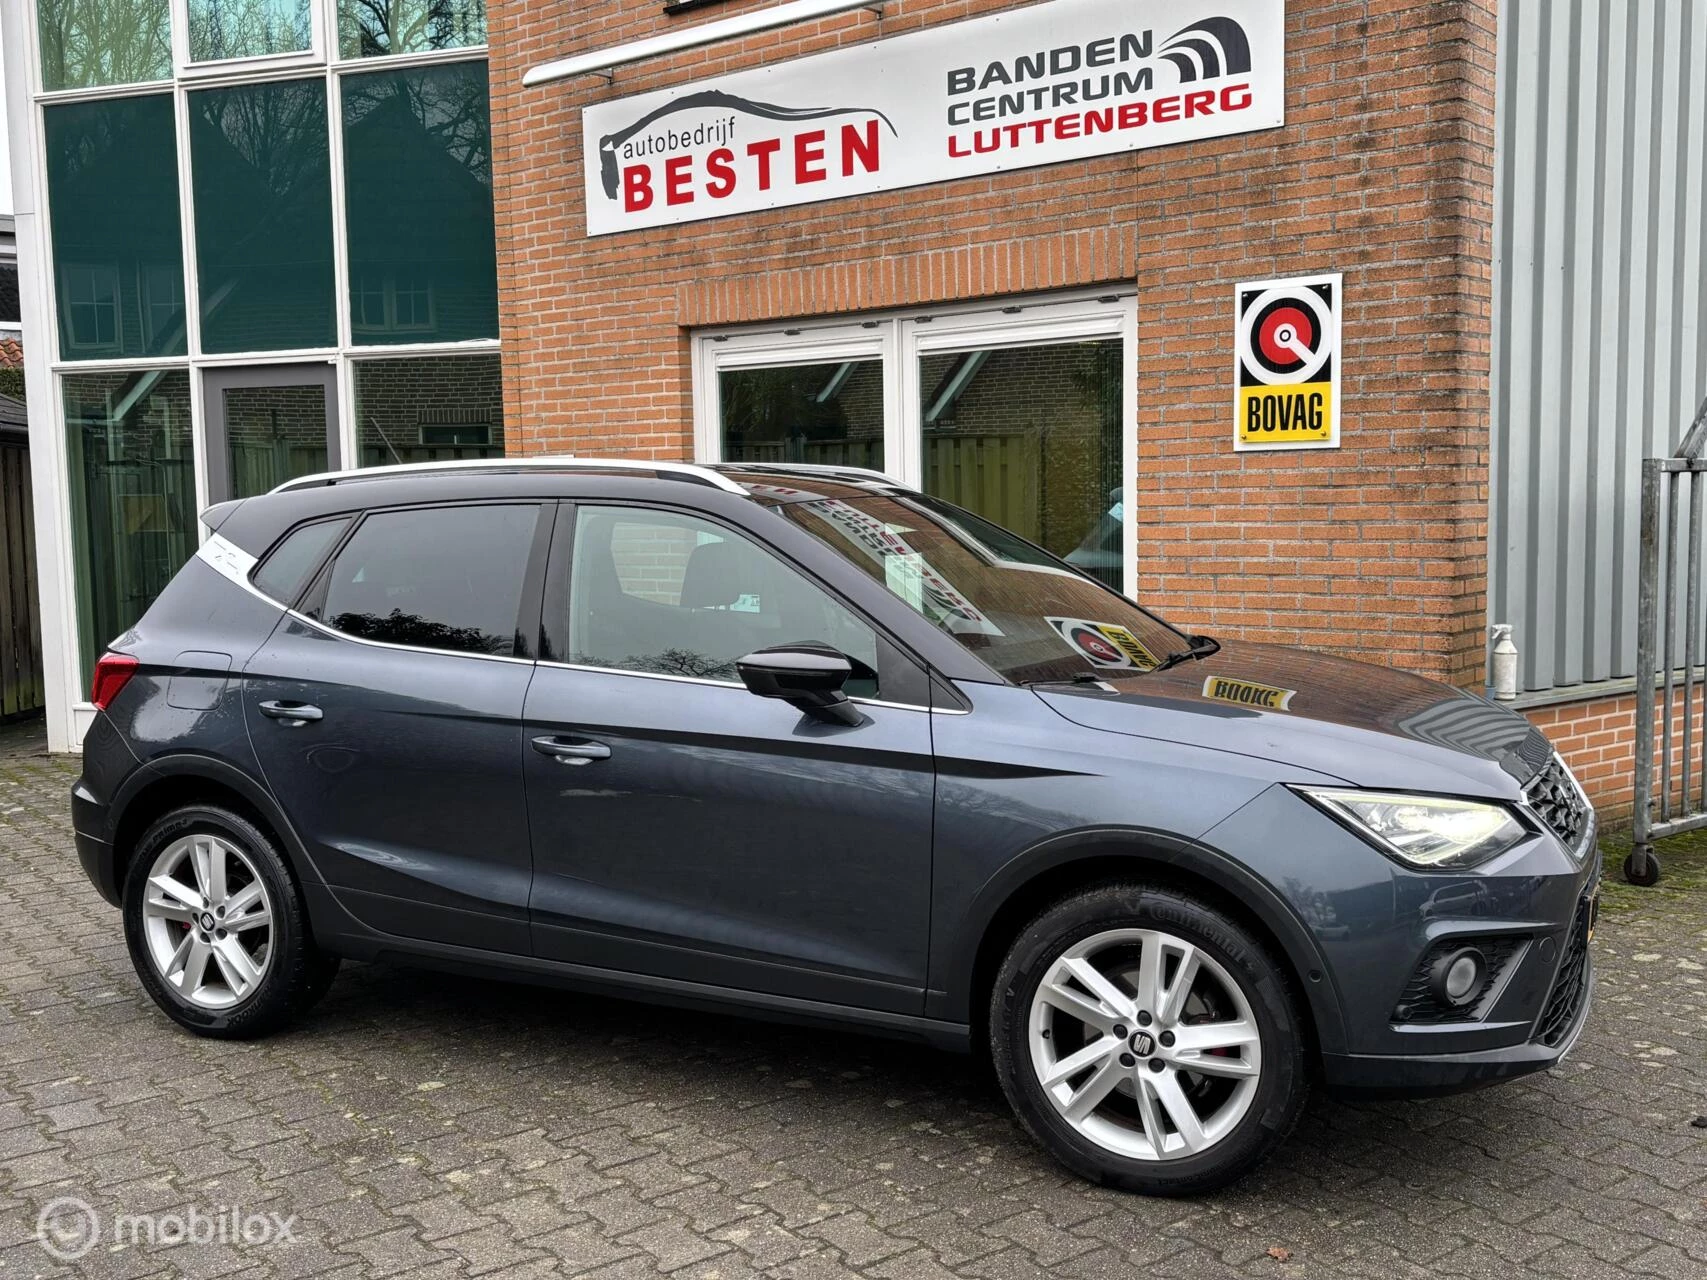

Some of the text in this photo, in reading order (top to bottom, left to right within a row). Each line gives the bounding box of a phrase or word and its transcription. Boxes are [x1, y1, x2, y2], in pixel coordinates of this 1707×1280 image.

[947, 29, 1153, 96] BANDEN
[947, 67, 1153, 126] CENTRUM
[948, 83, 1252, 158] LUTTENBERG
[623, 116, 736, 160] autobedrijf
[623, 119, 880, 213] BESTEN
[1246, 392, 1324, 433] BOVAG
